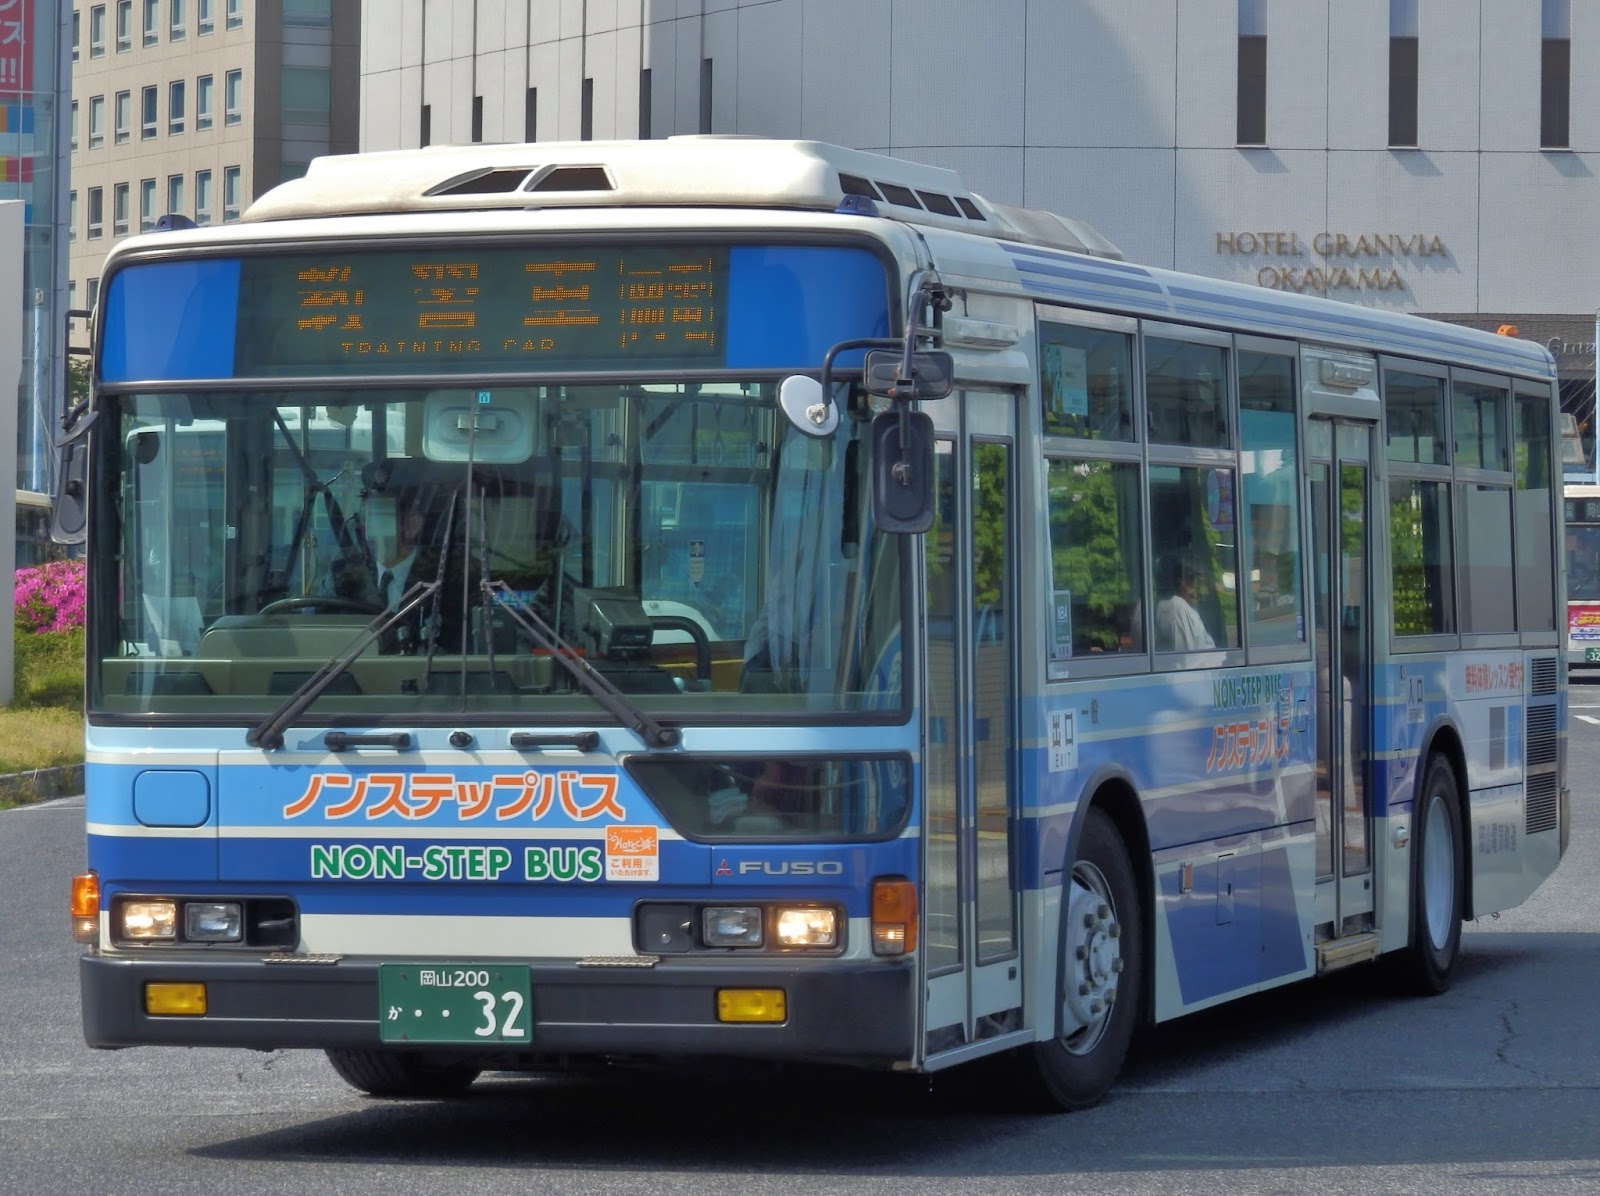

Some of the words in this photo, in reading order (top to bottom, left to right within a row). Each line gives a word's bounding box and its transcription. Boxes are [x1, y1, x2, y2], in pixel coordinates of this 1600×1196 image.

[1215, 231, 1304, 256] HOTEL
[1313, 231, 1448, 258] GRANVIA
[1257, 265, 1404, 292] OKAYAMA
[1212, 674, 1262, 711] NON-STEP
[1052, 712, 1074, 748] 出口
[1055, 752, 1072, 768] EXIT
[283, 770, 627, 822] ノンステップバス
[311, 844, 513, 881] NON-STEP
[524, 845, 603, 883] BUS
[739, 861, 844, 875] FUSO
[388, 1006, 403, 1021] か
[473, 990, 525, 1037] 32
